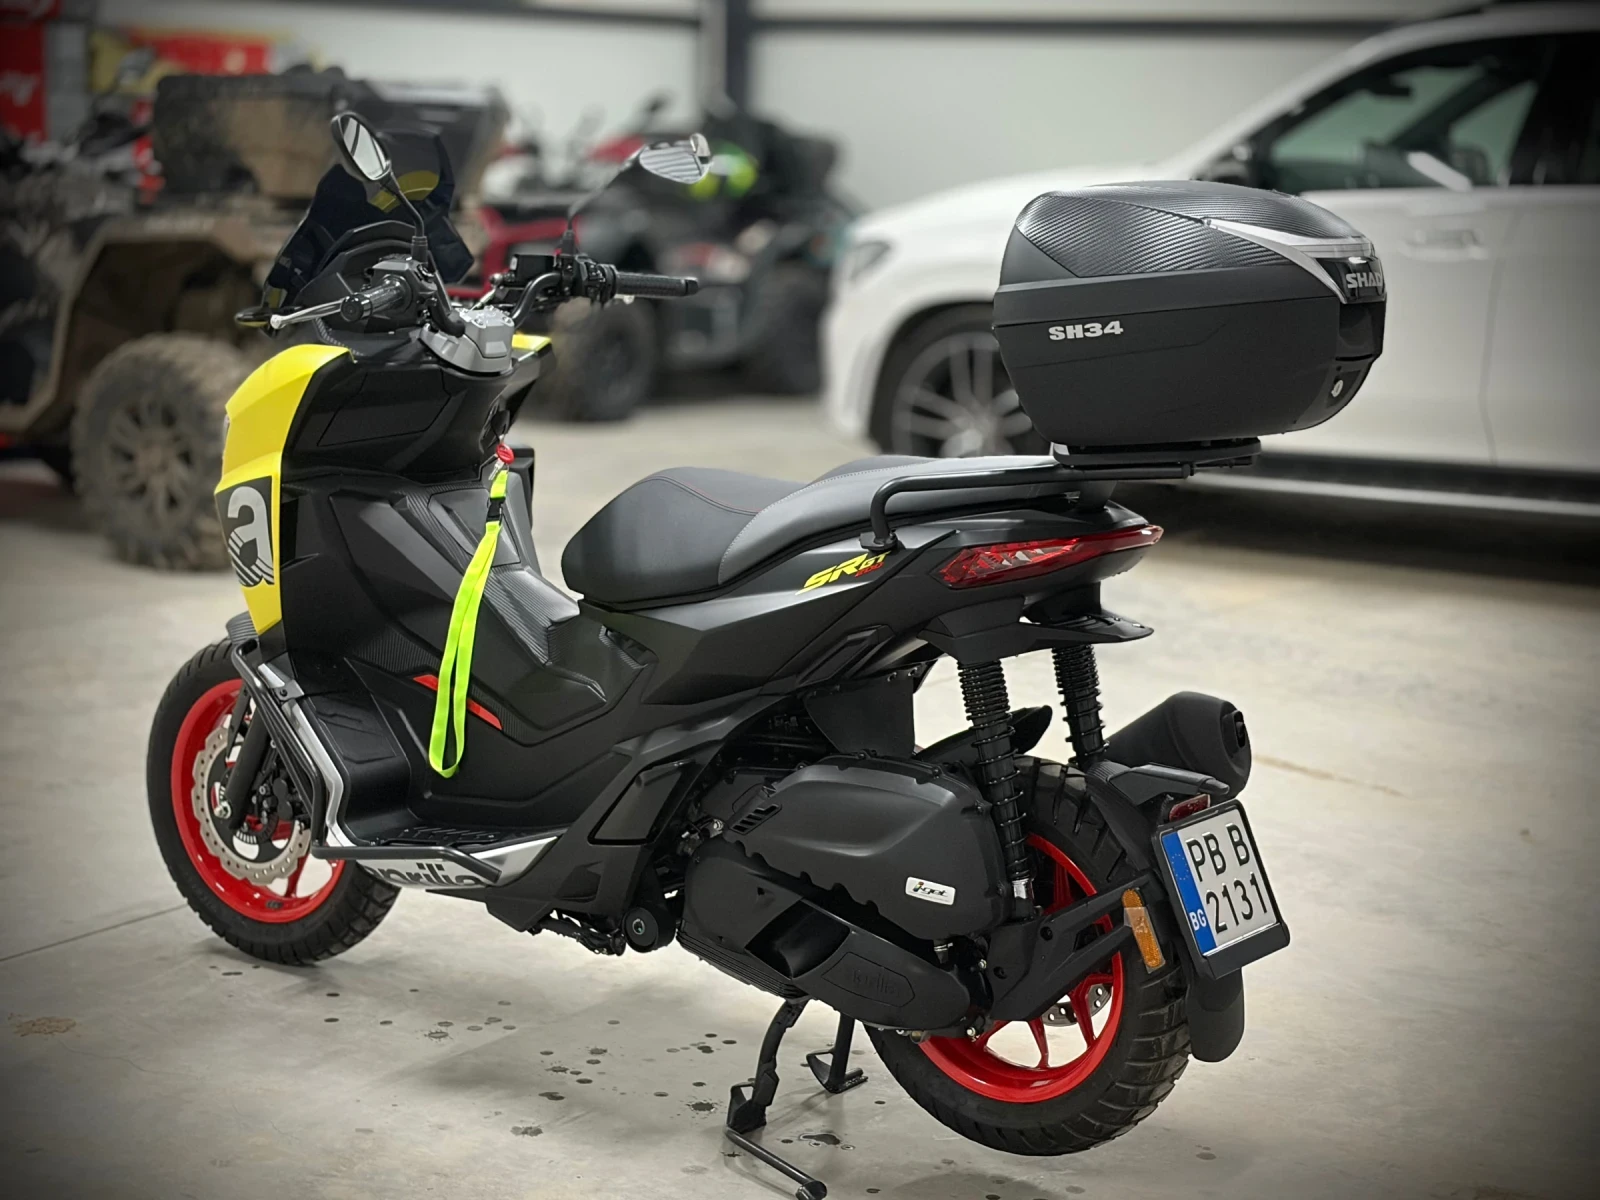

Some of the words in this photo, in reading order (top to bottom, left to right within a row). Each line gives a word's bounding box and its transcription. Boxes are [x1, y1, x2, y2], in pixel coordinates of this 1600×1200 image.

[1048, 320, 1124, 341] SH34
[1184, 831, 1227, 882] PB
[1225, 822, 1250, 866] B
[1188, 908, 1207, 932] BG
[1205, 871, 1268, 935] 2131
